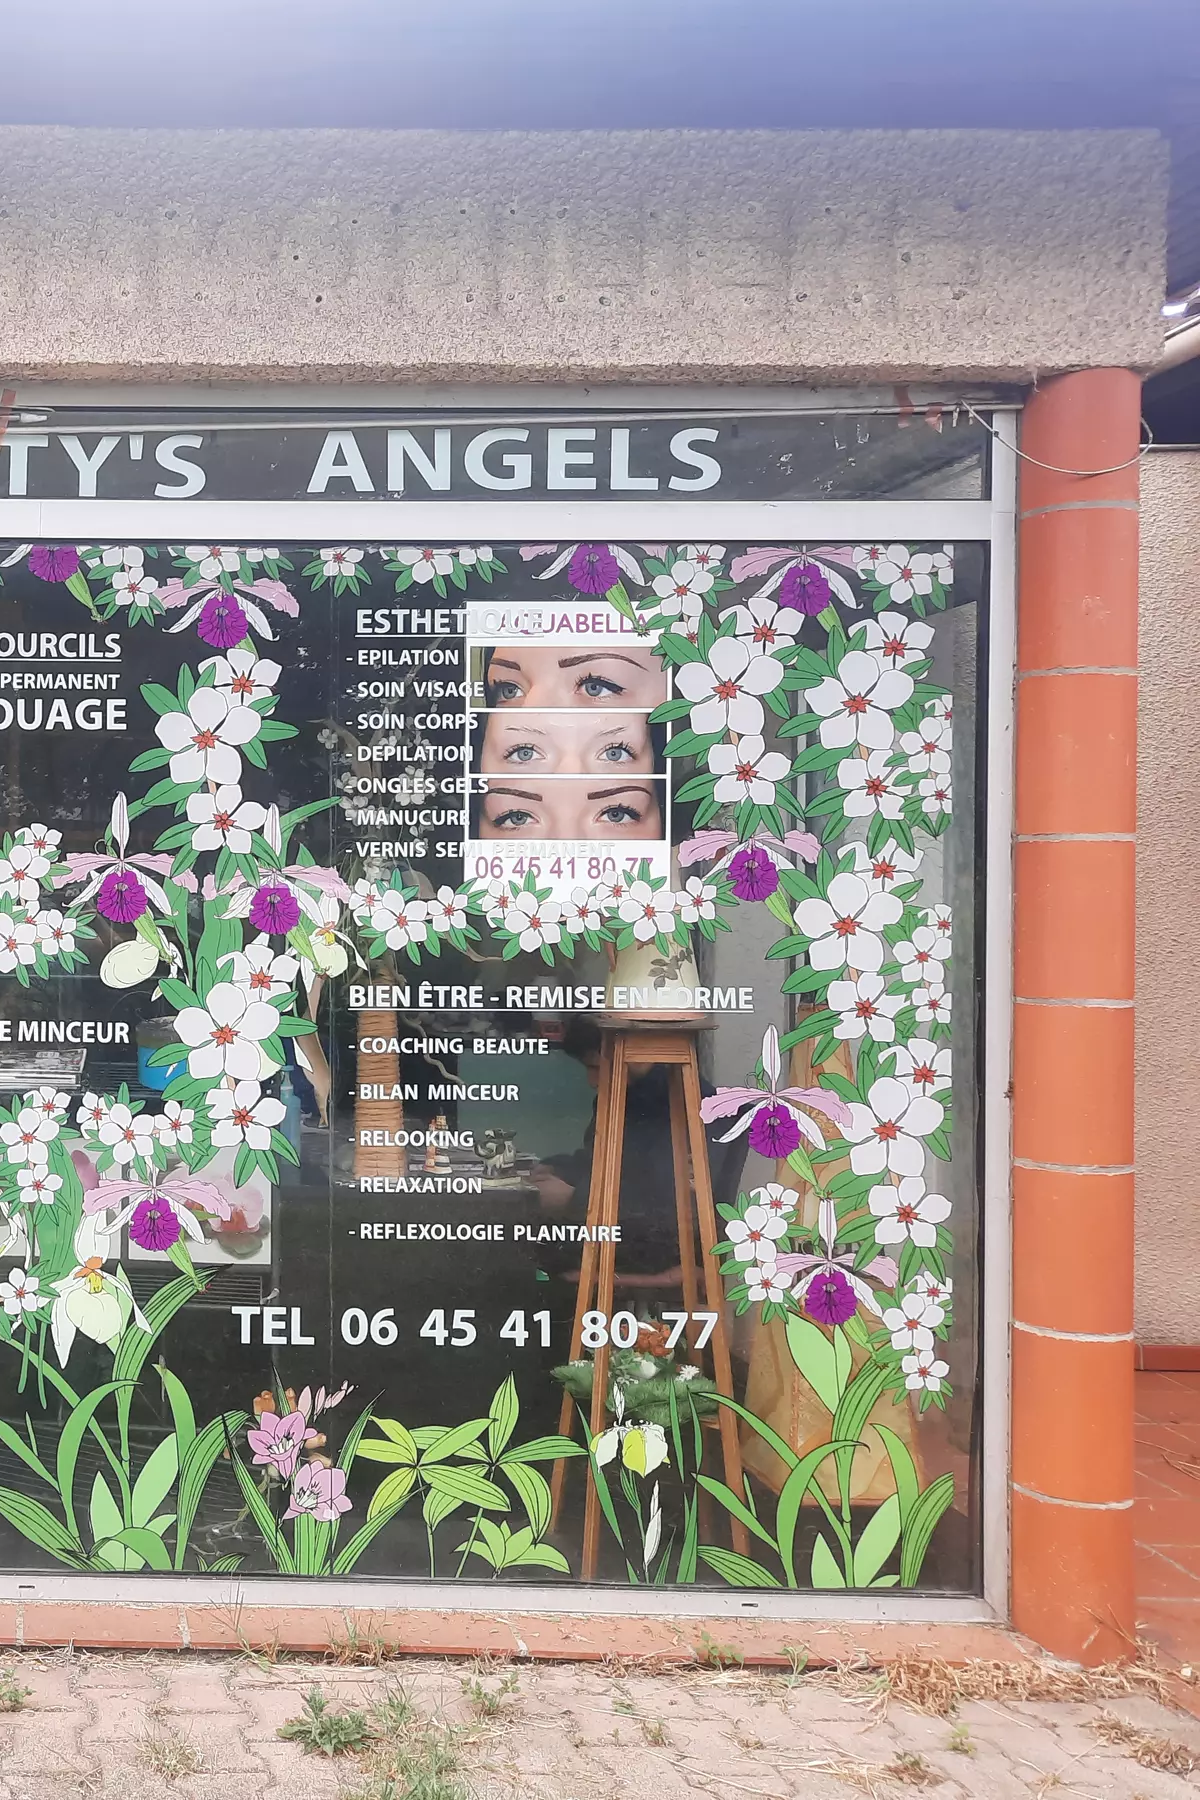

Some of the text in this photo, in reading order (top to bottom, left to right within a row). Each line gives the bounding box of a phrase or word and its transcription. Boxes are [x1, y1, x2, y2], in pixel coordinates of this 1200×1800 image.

[305, 426, 723, 495] ANGELS
[357, 649, 459, 666] EPILATION
[0, 673, 120, 690] PERMANENT
[357, 681, 405, 698] SOIN
[413, 681, 485, 698] VISAGE
[357, 713, 405, 730] SOIN
[413, 713, 479, 730] CORPS
[357, 745, 473, 762] DEPILATION
[357, 777, 436, 794] ONGLES
[440, 777, 489, 794] GELS
[357, 810, 471, 826] MANUCURE
[356, 842, 427, 858] VERNIS
[435, 842, 481, 858] SEMI
[475, 856, 503, 879] 06
[512, 856, 541, 879] 45
[550, 856, 575, 879] 41
[348, 985, 410, 1009] BIEN
[419, 981, 484, 1009] ÊTRE
[505, 985, 606, 1009] REMISE
[614, 986, 650, 1009] EN
[18, 1021, 130, 1044] MINCEUR
[359, 1037, 463, 1055] COACHING
[473, 1037, 549, 1056] BEAUTE
[360, 1084, 418, 1101] BILAN
[428, 1084, 519, 1101] MINCEUR
[360, 1130, 474, 1148] RELOOKING
[360, 1177, 483, 1195] RELAXATION
[360, 1223, 505, 1242] REFLEXOLOGIE
[513, 1225, 622, 1243] PLANTAIRE
[231, 1306, 719, 1349] TEL 06 45 41 80 77
